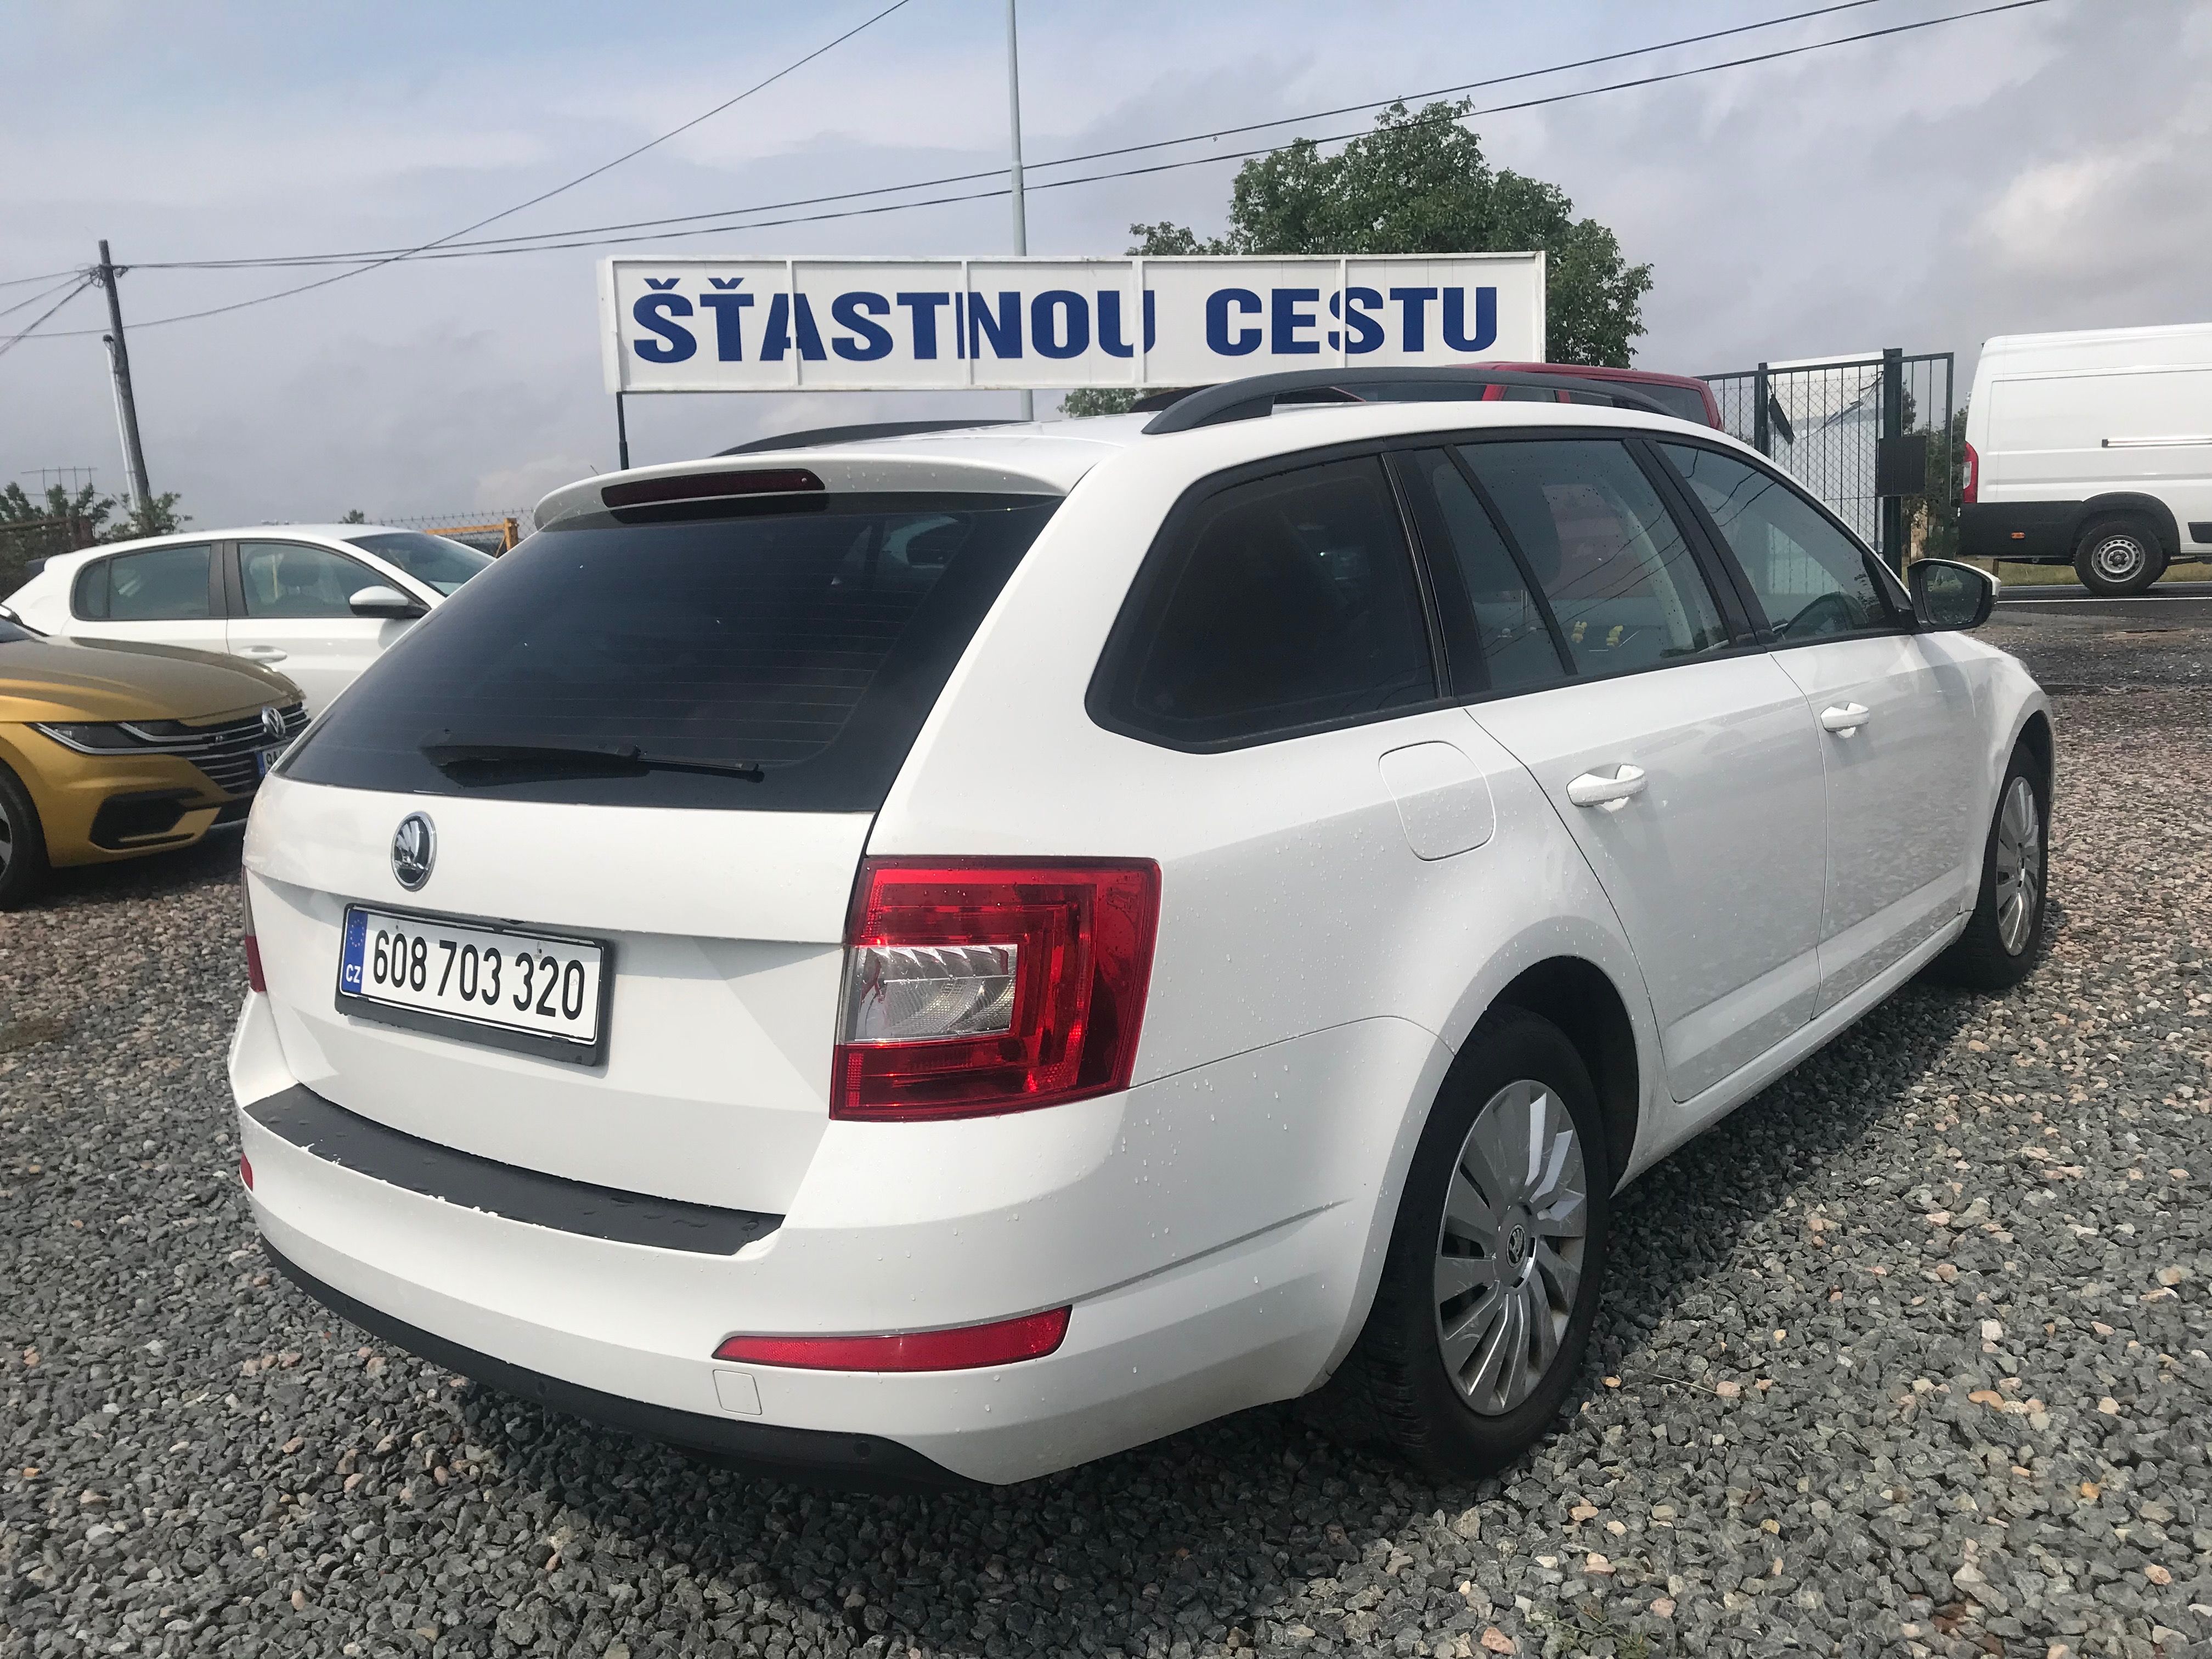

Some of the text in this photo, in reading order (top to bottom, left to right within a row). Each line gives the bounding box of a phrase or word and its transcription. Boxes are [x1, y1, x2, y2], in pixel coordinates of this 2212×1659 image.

[633, 278, 1497, 363] ŠŤASTNOU CESTU
[346, 963, 361, 984] CZ
[373, 930, 585, 1020] 608 703 320
